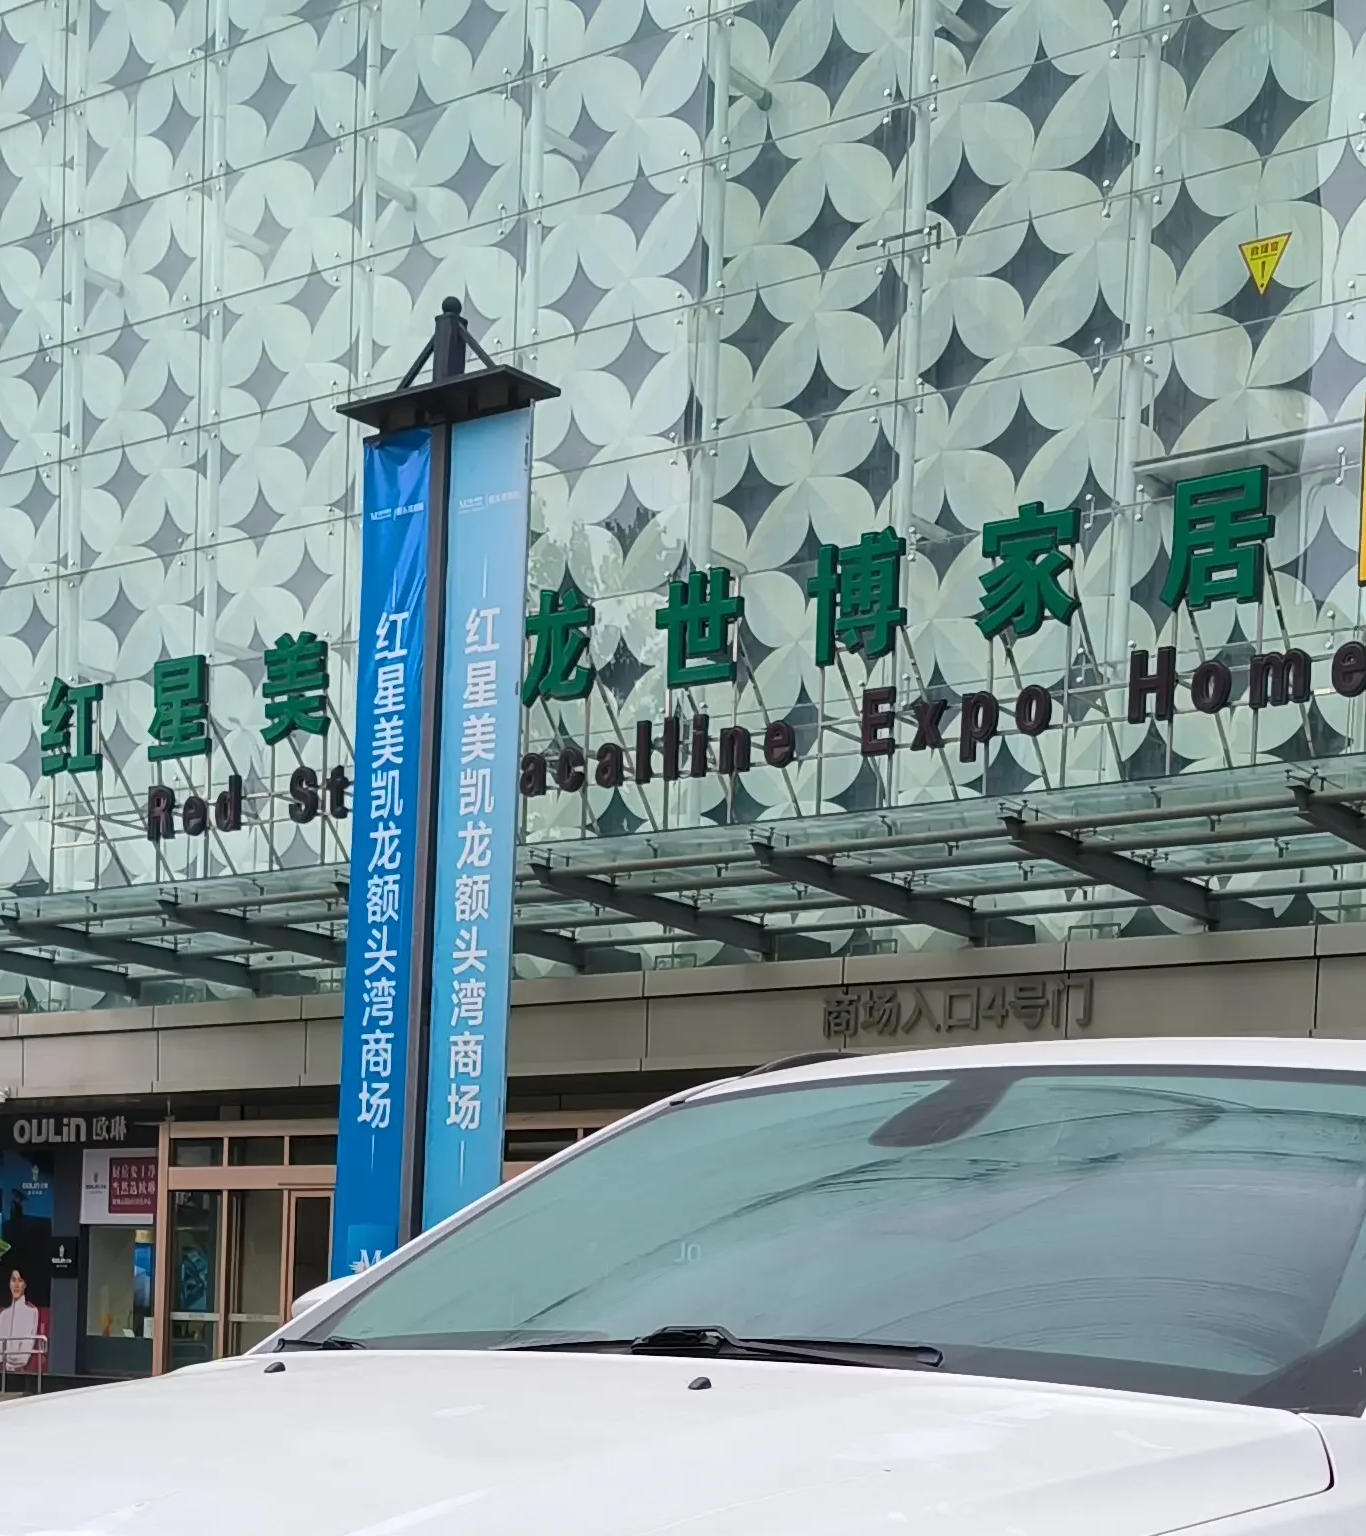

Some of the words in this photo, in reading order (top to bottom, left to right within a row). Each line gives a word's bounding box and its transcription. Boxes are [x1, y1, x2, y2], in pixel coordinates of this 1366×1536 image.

[40, 464, 1275, 778] 红星美龙世博家居
[147, 773, 243, 841] Red
[519, 713, 796, 798] acalline
[860, 684, 1053, 764] Expo
[357, 611, 410, 1130] 红星美凯龙额头湾商场
[446, 607, 501, 1131] 红星美凯龙额头湾商场
[822, 976, 1095, 1039] 商场入口4号门
[92, 1115, 127, 1141] 欧琳
